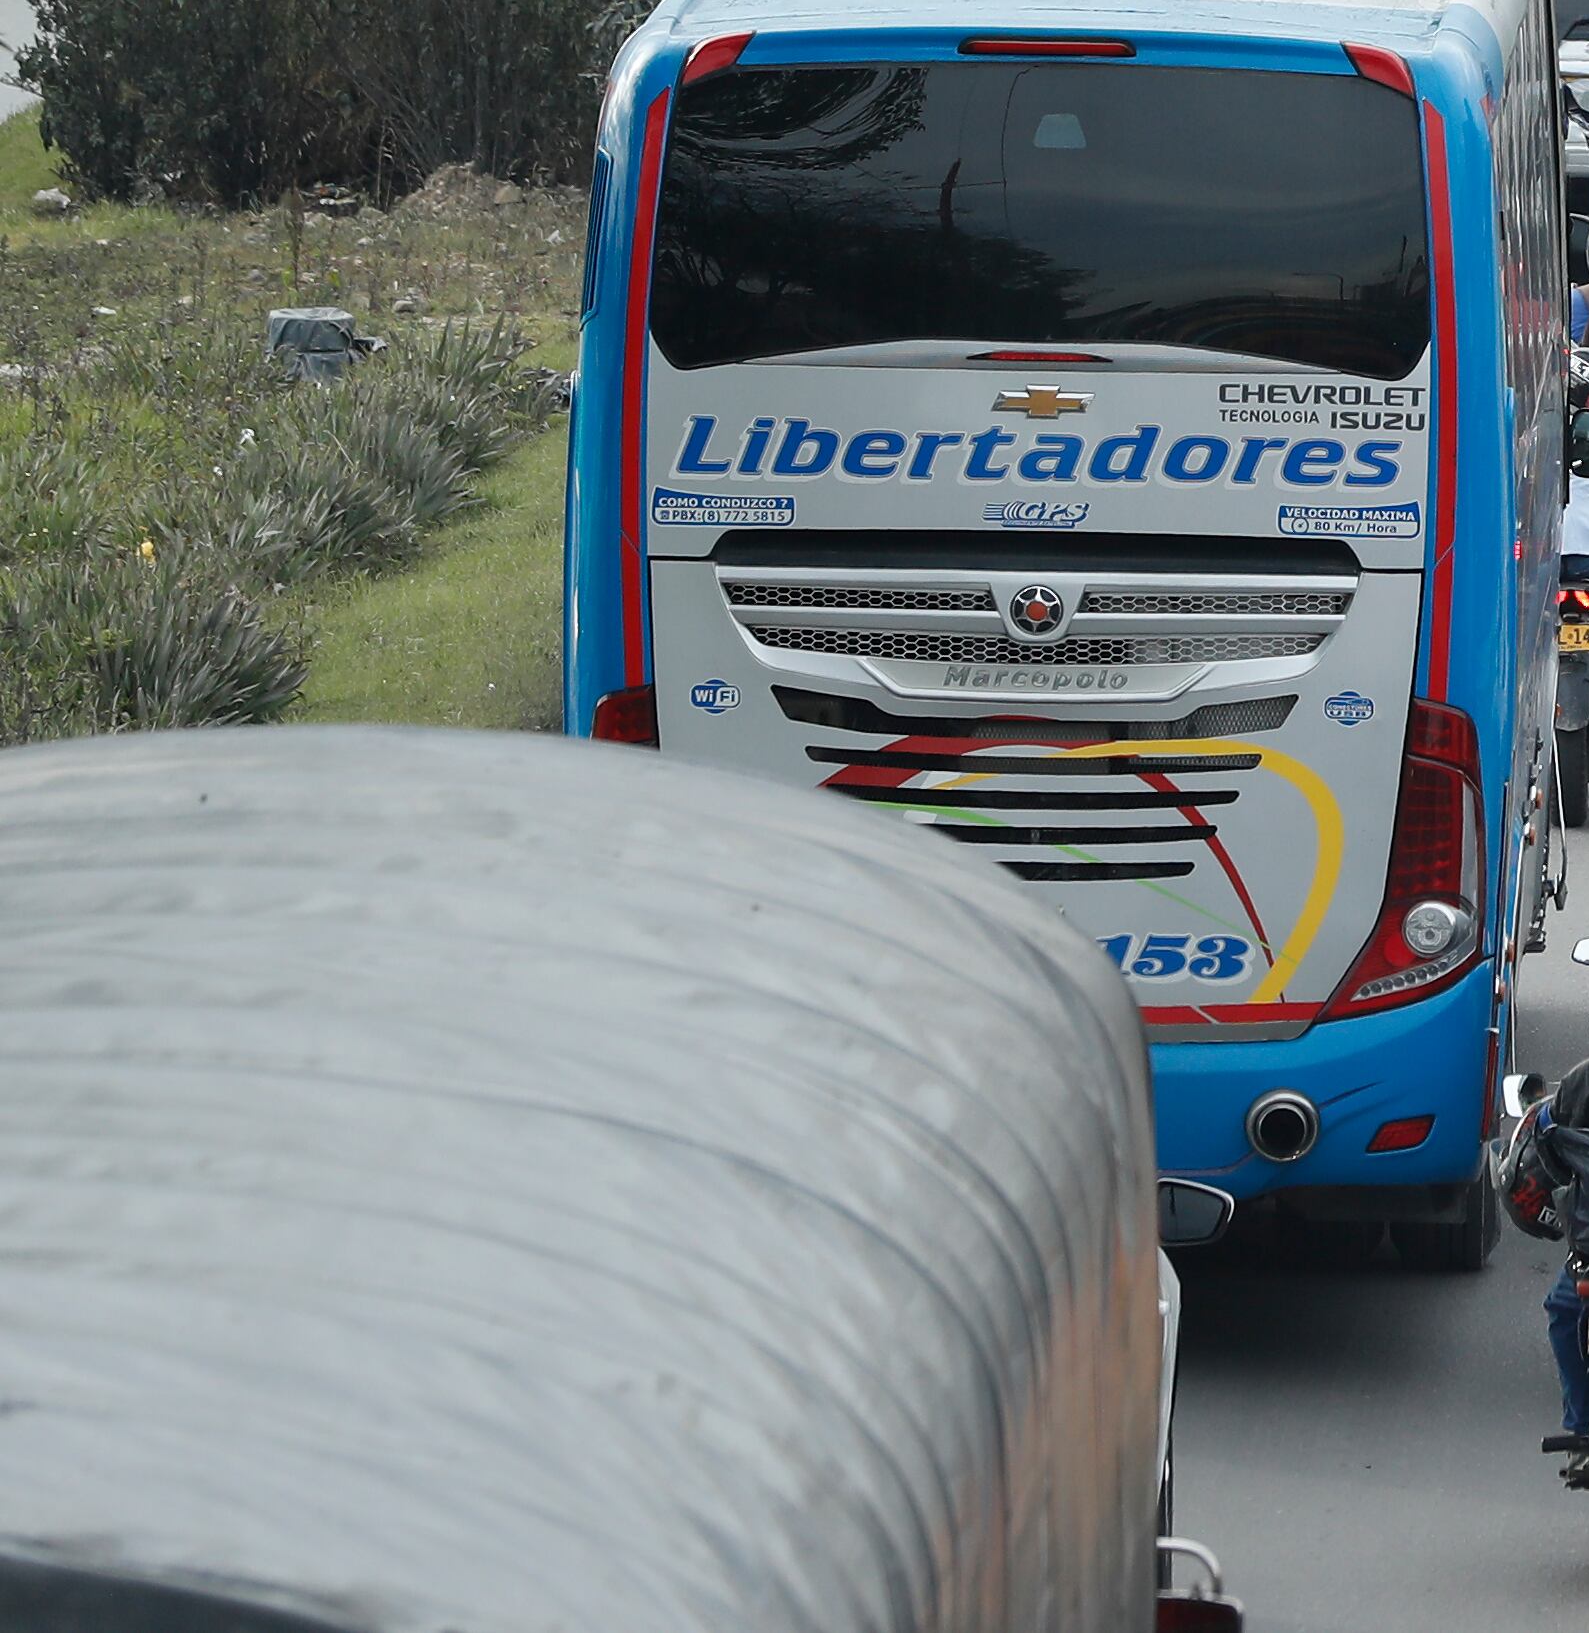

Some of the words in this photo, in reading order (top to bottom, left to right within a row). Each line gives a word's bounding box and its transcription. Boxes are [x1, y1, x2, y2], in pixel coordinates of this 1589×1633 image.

[1217, 383, 1426, 408] CHEVROLET
[1218, 409, 1321, 425] TECNOLOGIA
[1329, 410, 1426, 432] ISUZU
[673, 414, 1405, 489] Libertadores
[657, 496, 699, 509] COMO
[701, 497, 777, 510] CONDUZCO
[780, 498, 788, 509] ?
[1020, 500, 1092, 522] GPS
[1284, 506, 1360, 520] VELOCIDAD
[1362, 508, 1416, 522] MAXIMA
[723, 510, 749, 524] 772
[752, 510, 787, 524] 5815
[1313, 521, 1332, 533] 80
[1366, 522, 1398, 534] Hora
[941, 664, 1130, 693] Marcopolo
